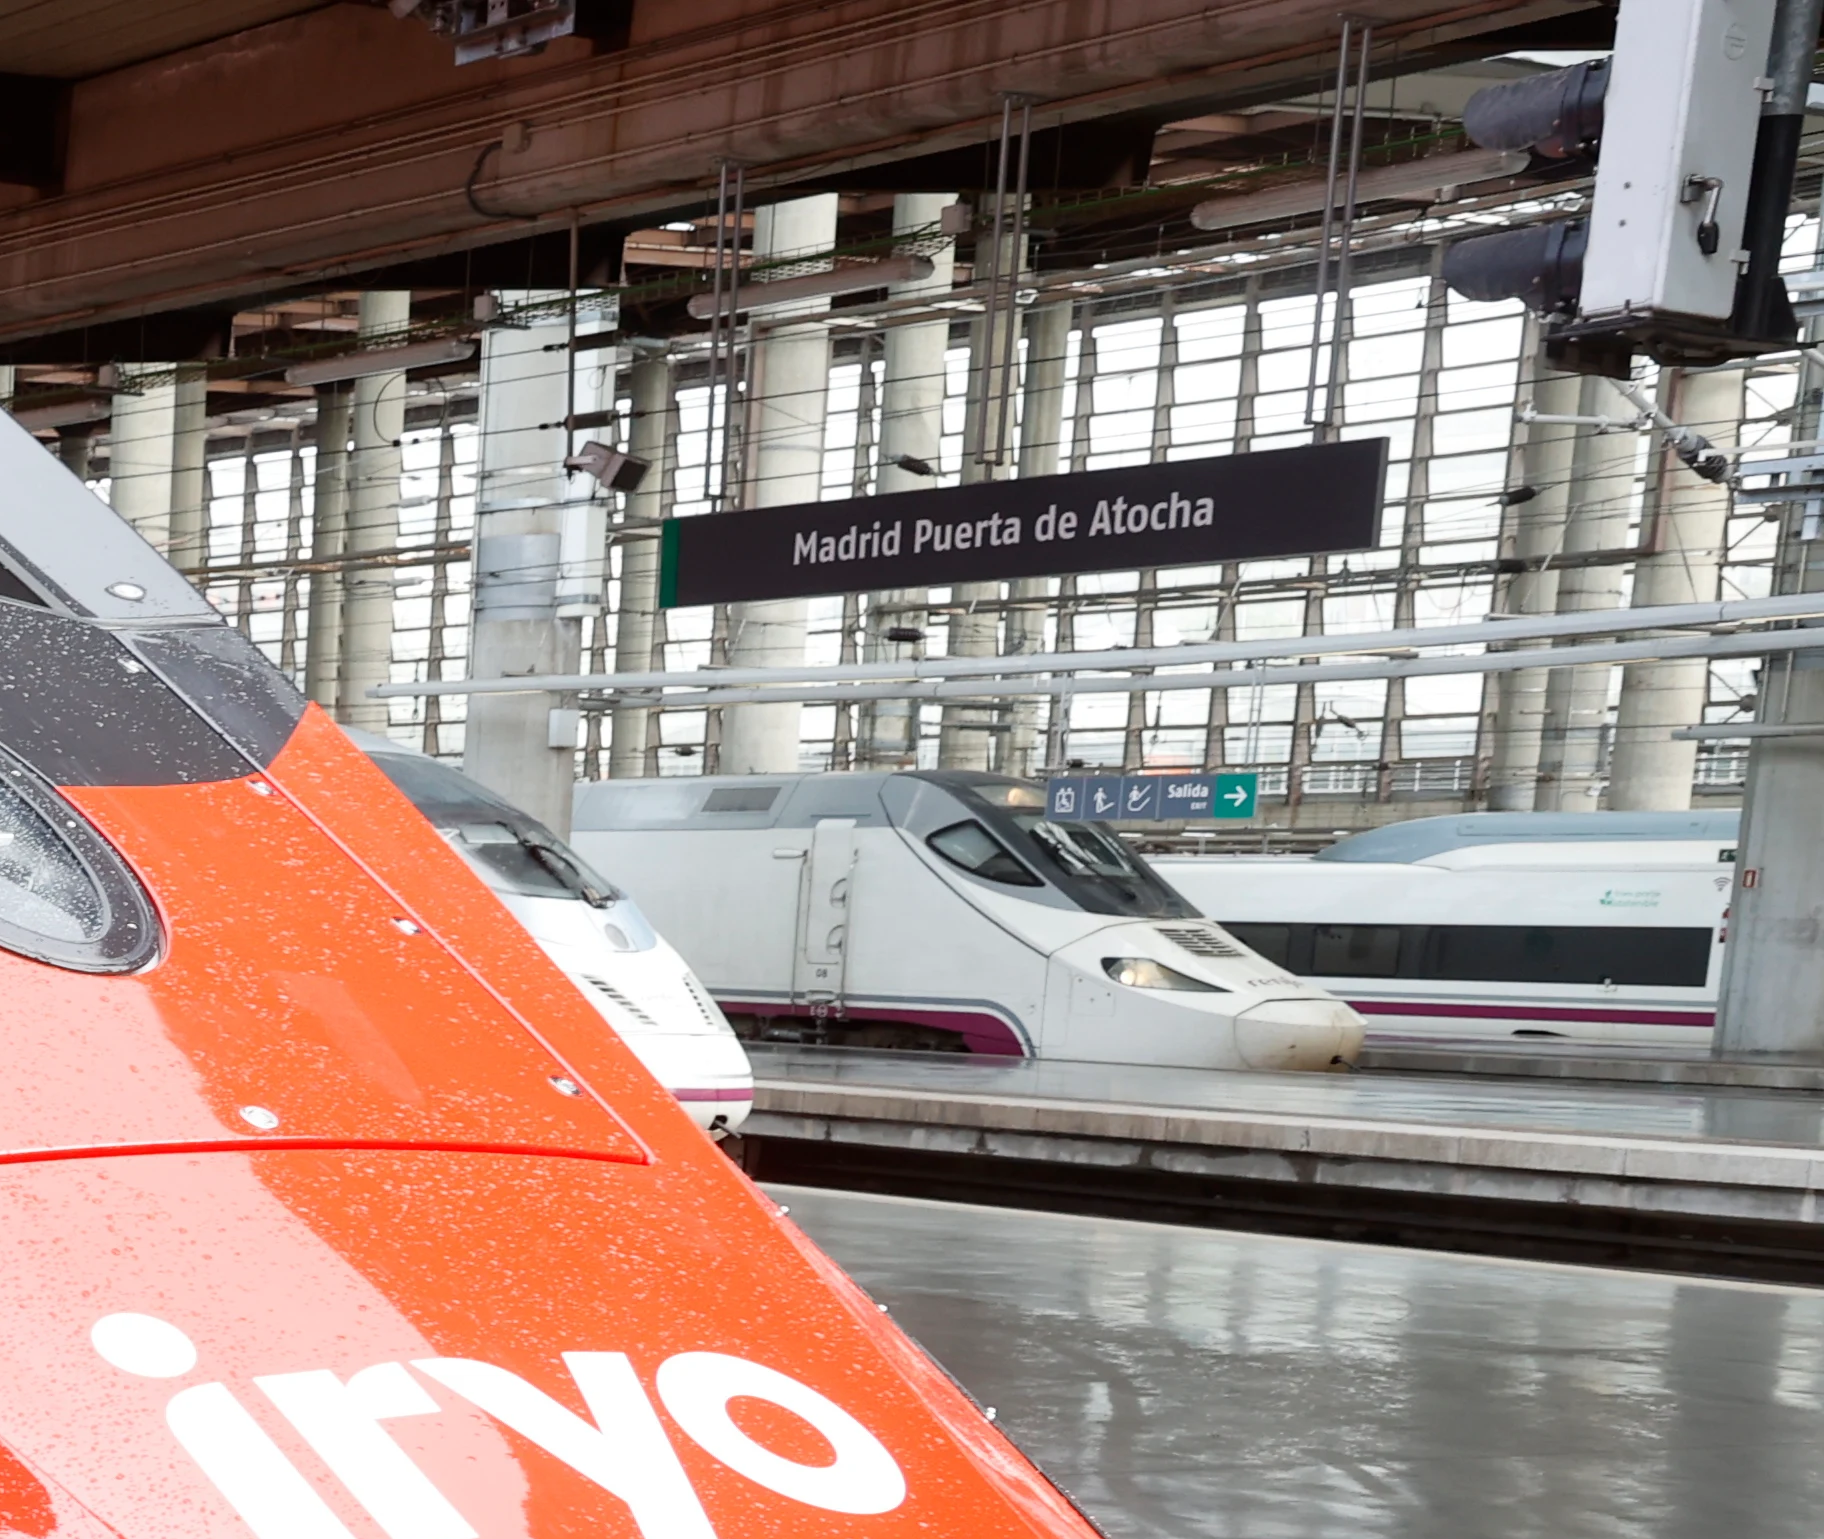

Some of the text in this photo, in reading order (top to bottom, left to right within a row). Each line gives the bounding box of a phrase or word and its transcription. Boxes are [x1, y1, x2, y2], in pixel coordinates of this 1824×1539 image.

[792, 491, 1215, 565] Madrid Puerta de Atocha
[1167, 783, 1209, 799] Salida
